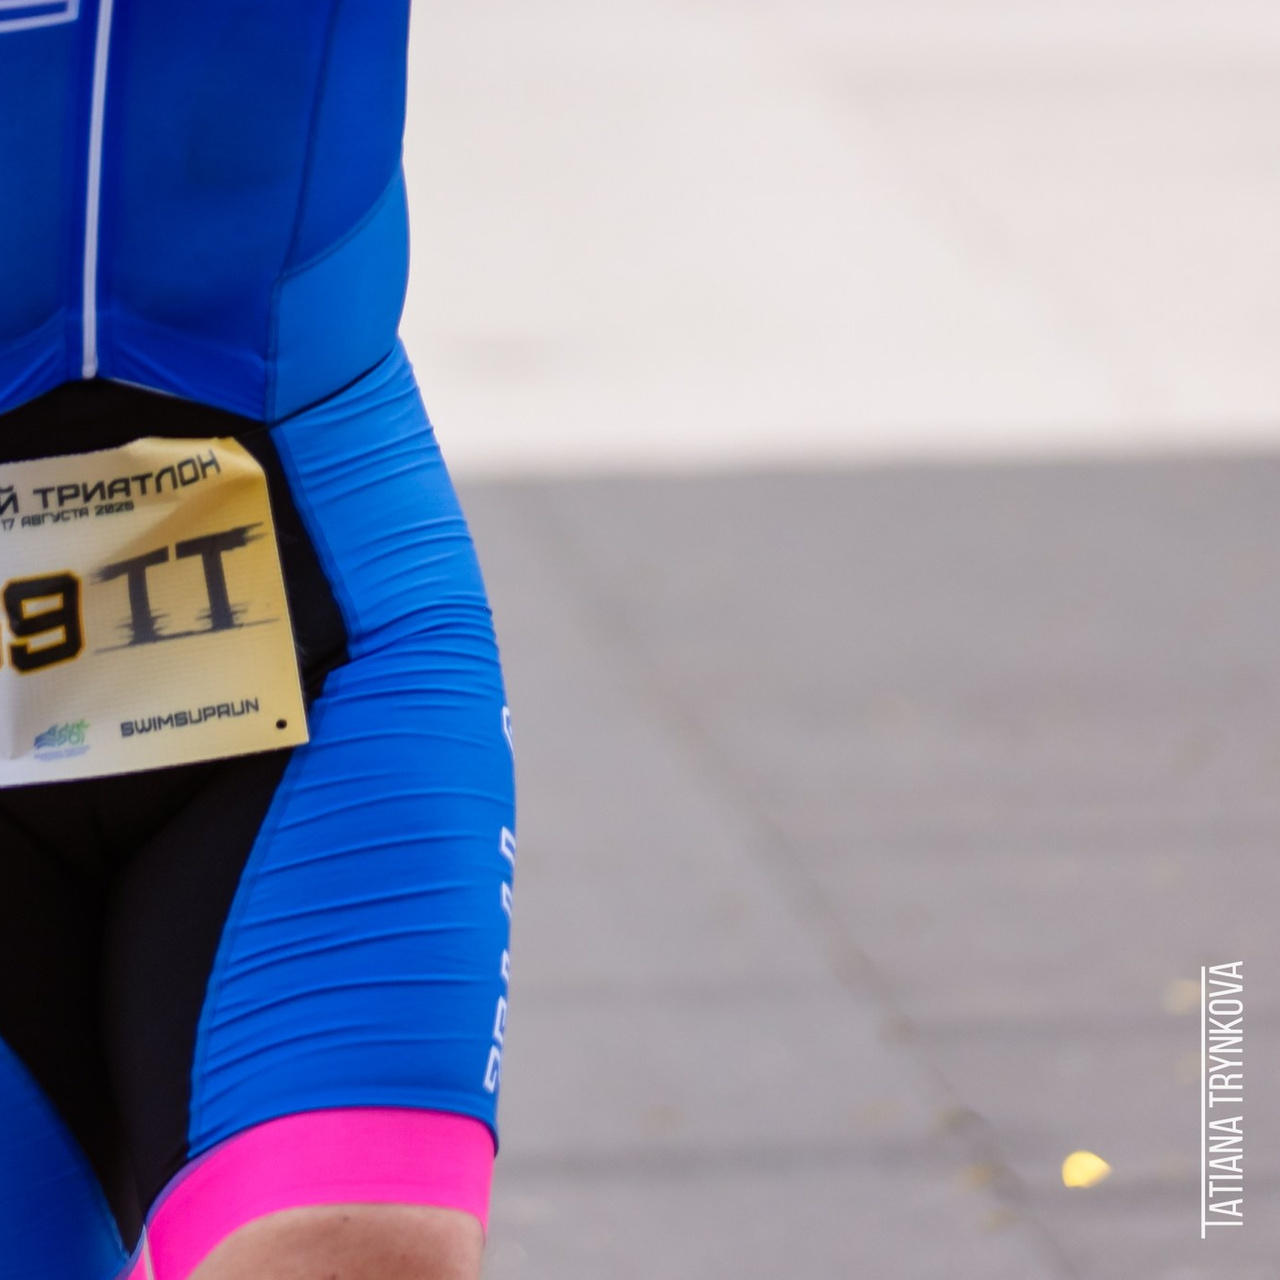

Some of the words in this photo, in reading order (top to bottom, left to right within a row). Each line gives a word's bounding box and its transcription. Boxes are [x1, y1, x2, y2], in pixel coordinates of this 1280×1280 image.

[33, 449, 221, 509] ТРИАТЛОН
[0, 518, 15, 531] 17
[21, 506, 89, 528] АВГУСТА
[120, 697, 260, 738] SWIMSUPRUN
